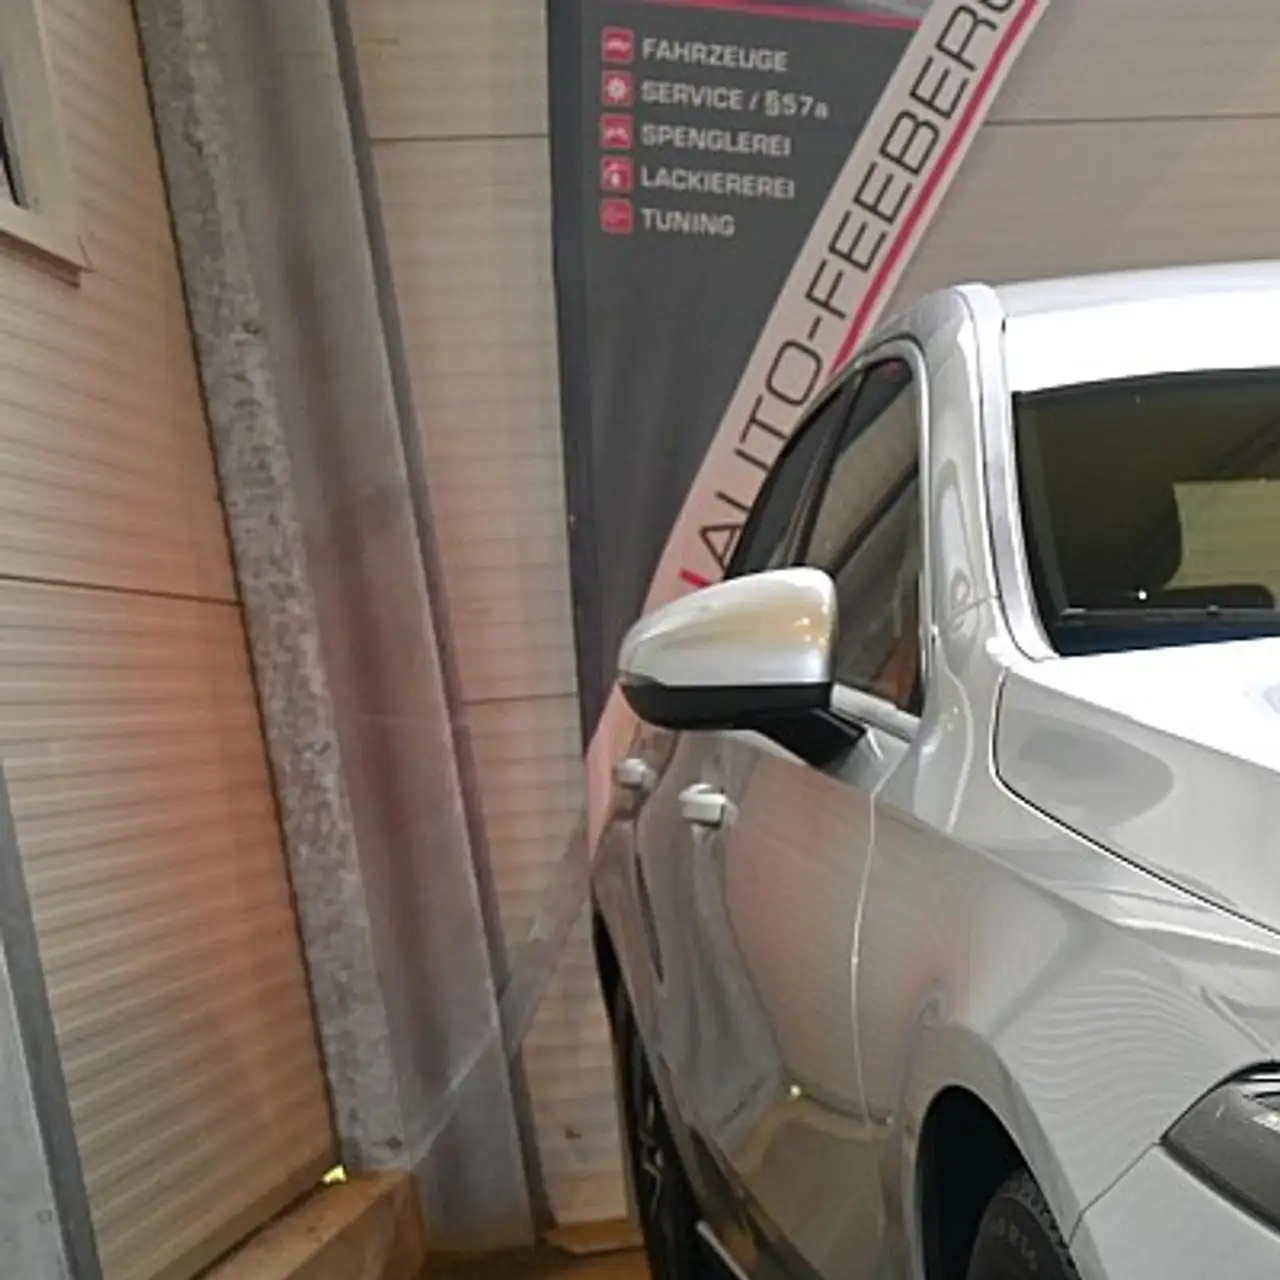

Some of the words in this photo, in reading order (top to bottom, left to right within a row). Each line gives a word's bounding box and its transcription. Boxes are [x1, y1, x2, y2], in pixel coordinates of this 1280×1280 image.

[641, 38, 789, 72] FAHRZEUGE
[640, 80, 744, 111] SERVICE
[764, 89, 829, 120] §57a
[640, 123, 792, 156] SPENGLEREI
[640, 166, 796, 199] LACKIEREREI
[640, 207, 736, 237] TUNING
